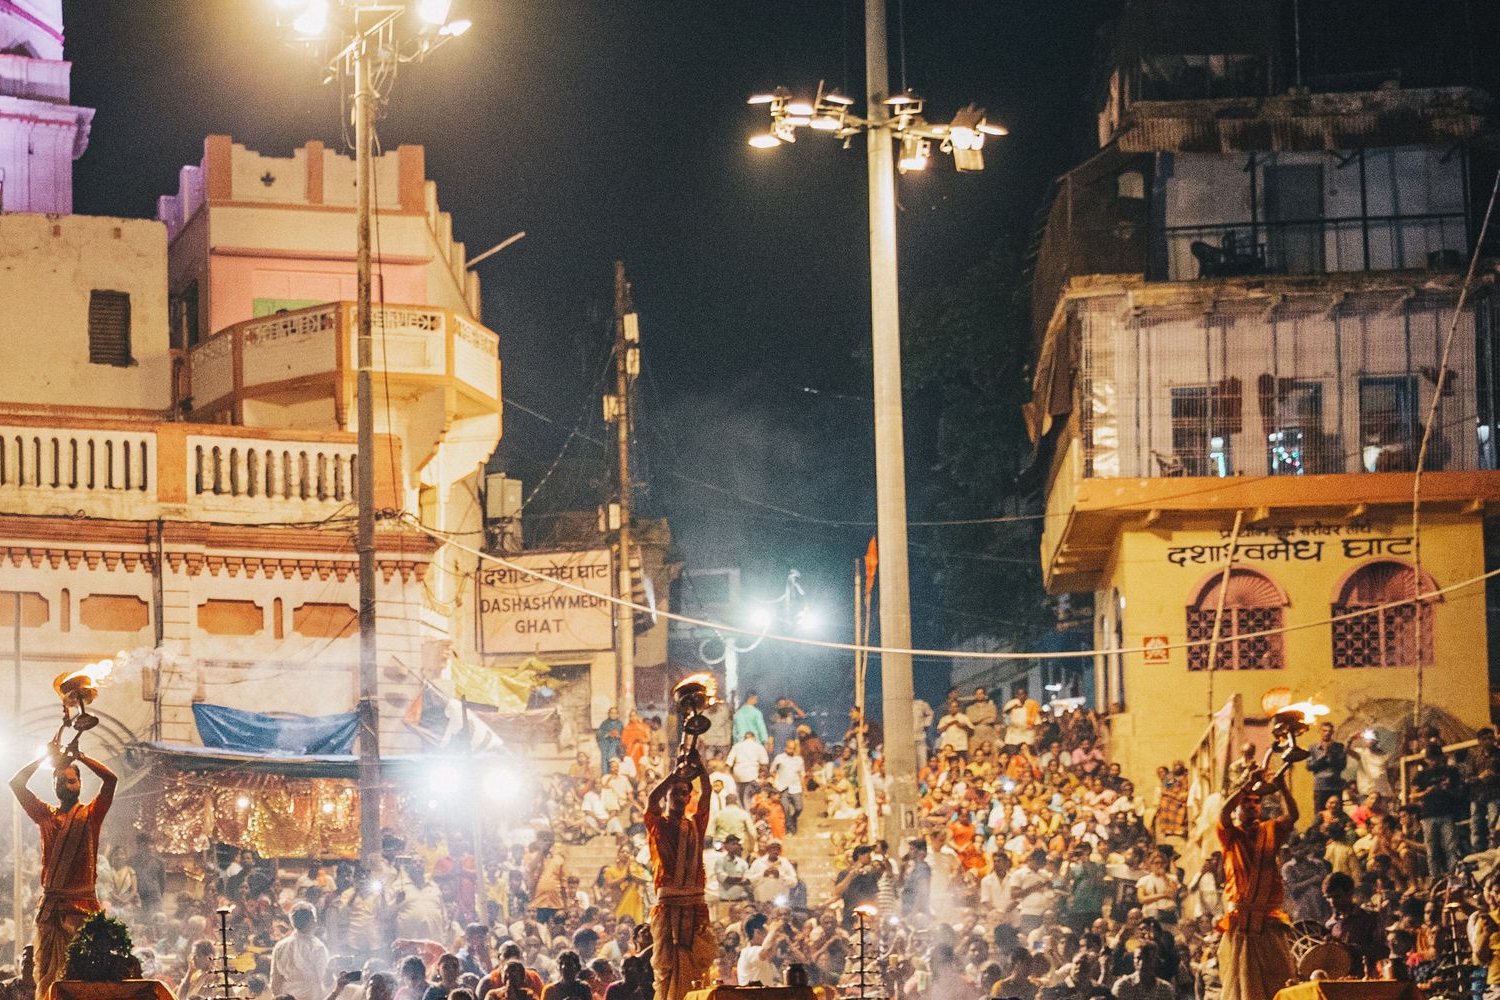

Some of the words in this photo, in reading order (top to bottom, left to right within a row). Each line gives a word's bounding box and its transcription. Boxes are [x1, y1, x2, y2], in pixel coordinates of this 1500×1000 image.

[1167, 539, 1324, 567] दशाश्वमेध
[1341, 536, 1414, 558] घाट
[484, 560, 573, 587] दशाश्वमेध
[578, 564, 608, 579] घाट
[480, 594, 607, 613] DASHASHWMEDH
[515, 619, 563, 634] GHAT
